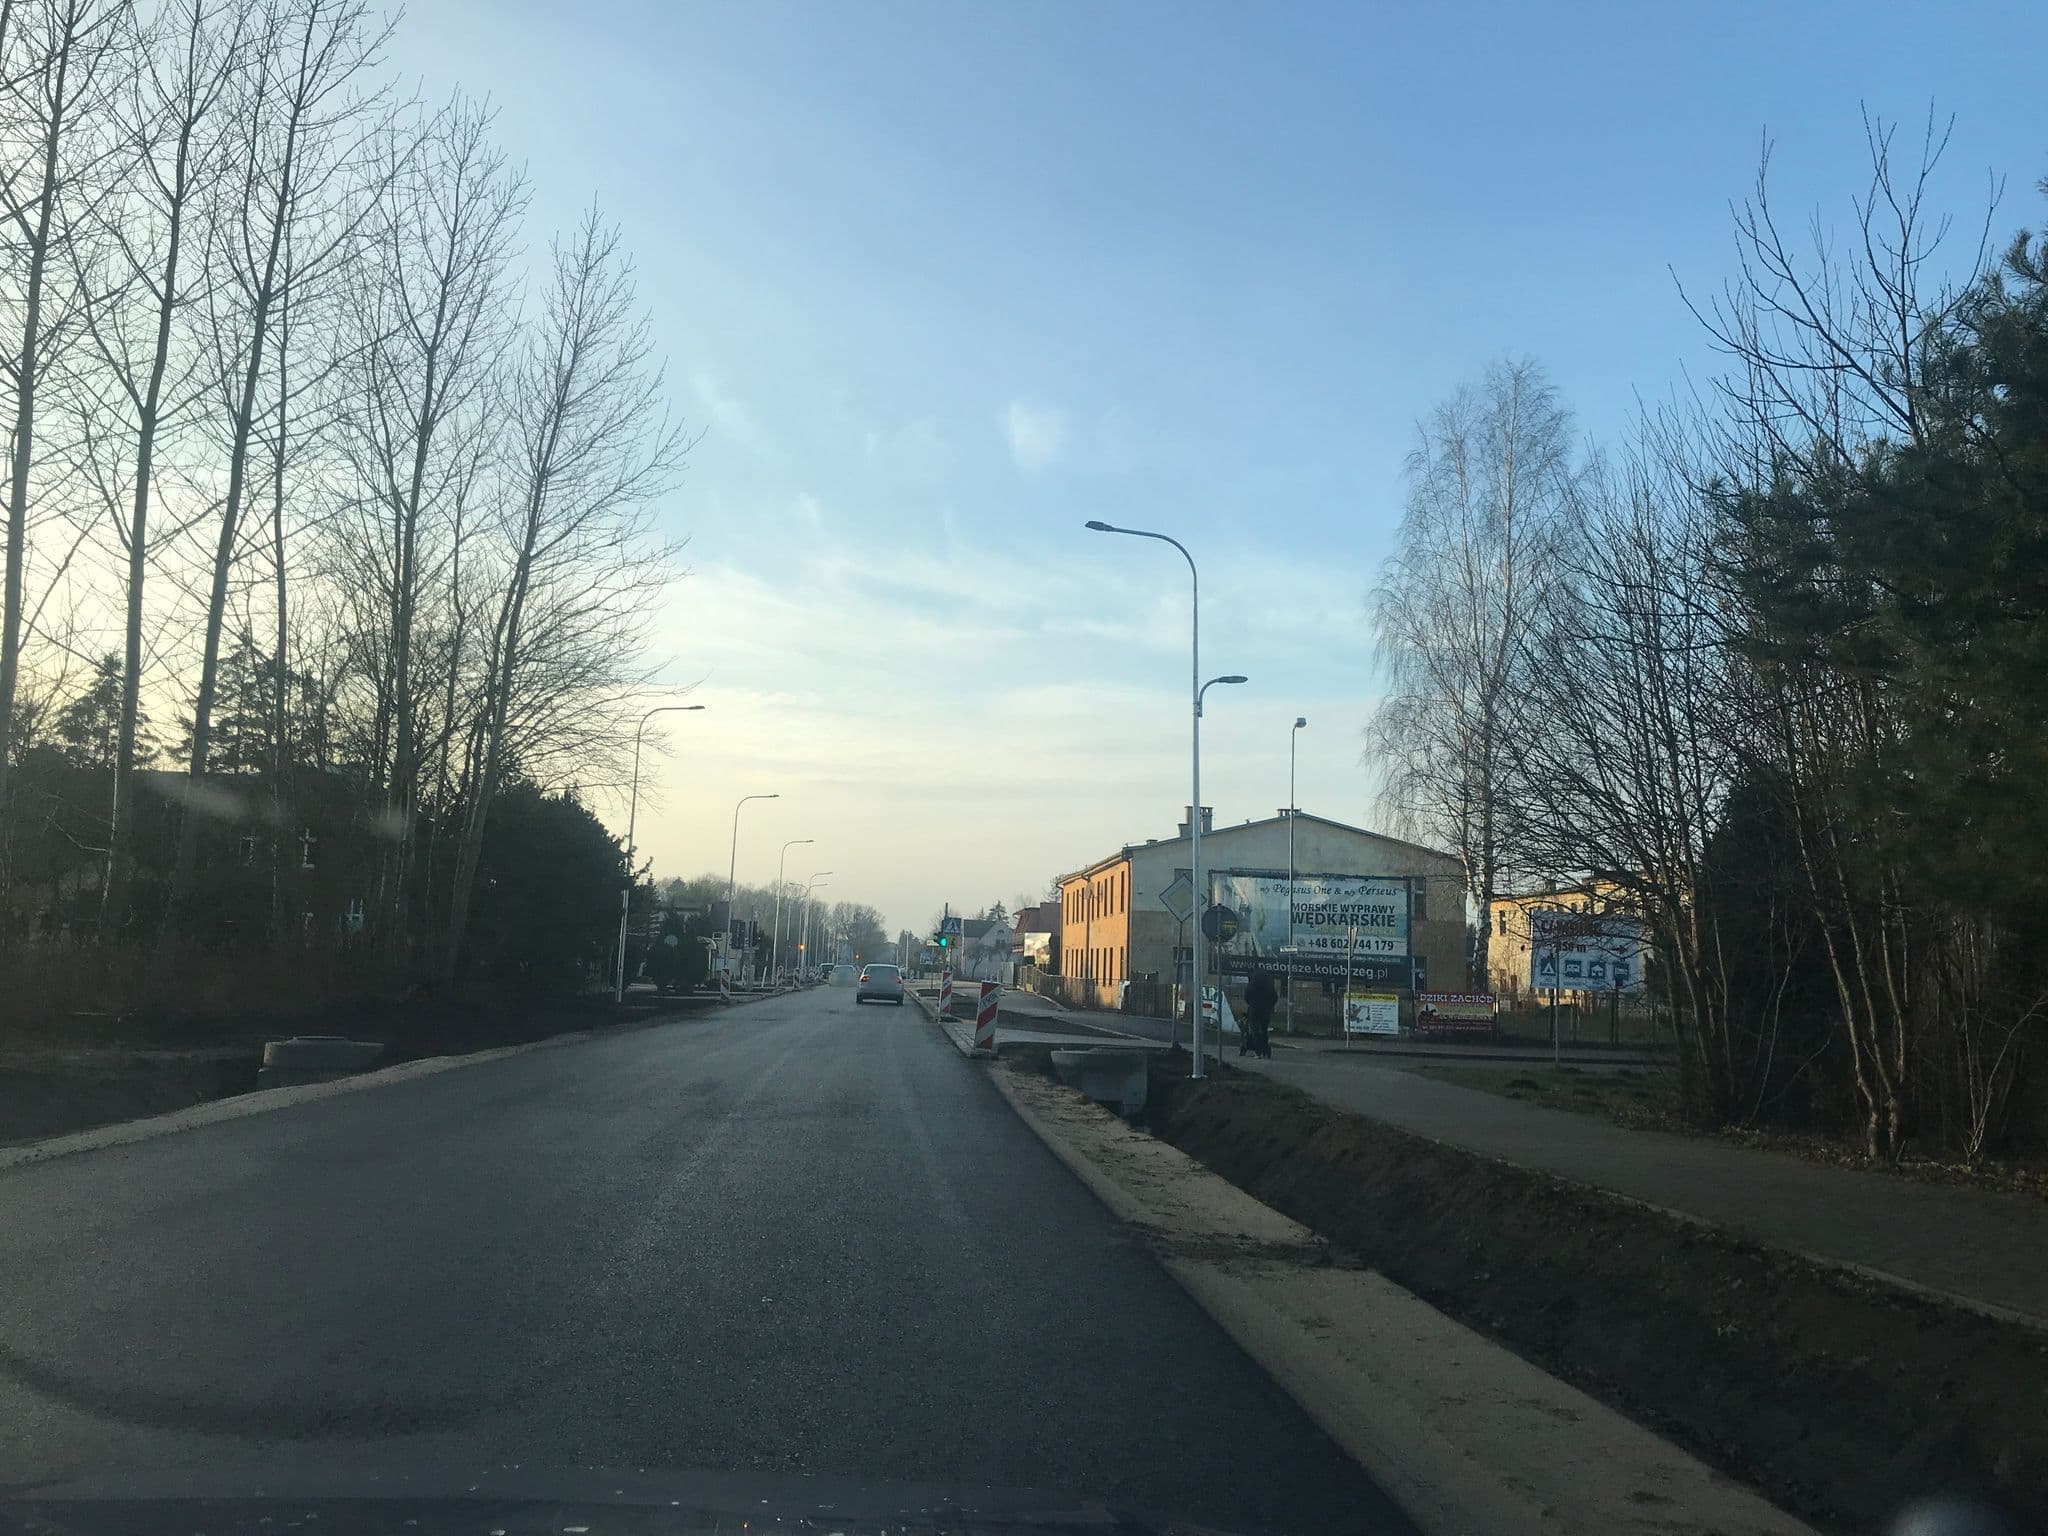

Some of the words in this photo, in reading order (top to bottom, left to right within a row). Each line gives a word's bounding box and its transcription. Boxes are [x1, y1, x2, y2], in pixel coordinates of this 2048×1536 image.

[1314, 886, 1332, 895] One
[1334, 887, 1341, 895] &
[1359, 886, 1397, 896] Perseus
[1292, 903, 1338, 912] MORSKIE
[1340, 904, 1395, 914] WYPRAWY
[1292, 912, 1396, 928] WĘDKARSKIE
[1309, 938, 1327, 948] +48
[1331, 939, 1349, 949] 602
[1375, 940, 1394, 951] 179
[1420, 994, 1447, 1002] DZIKI
[1450, 994, 1494, 1003] ZACHÓD
